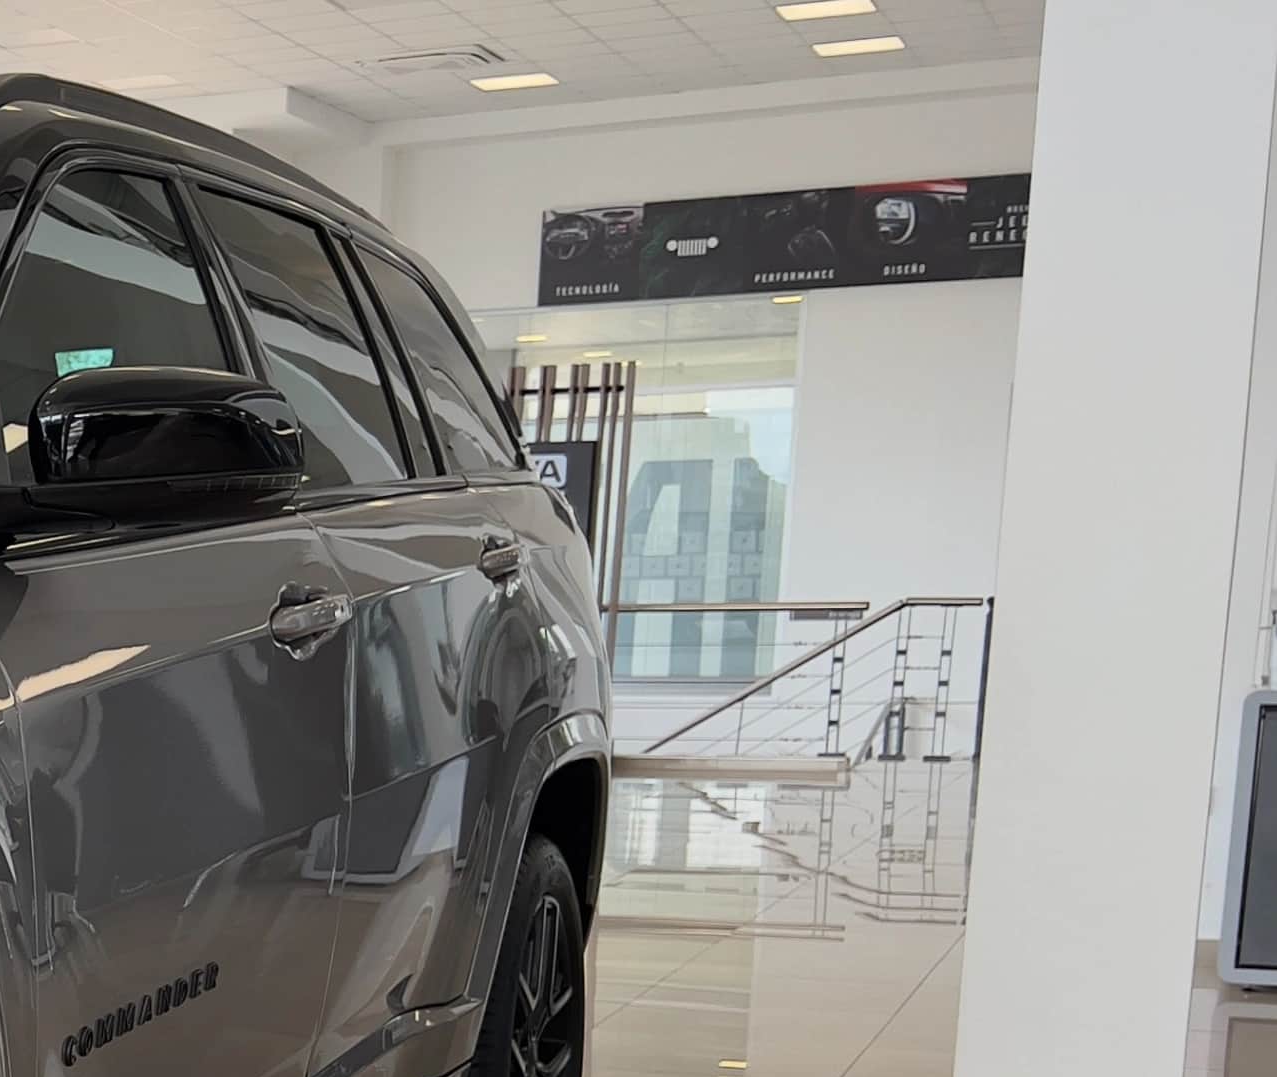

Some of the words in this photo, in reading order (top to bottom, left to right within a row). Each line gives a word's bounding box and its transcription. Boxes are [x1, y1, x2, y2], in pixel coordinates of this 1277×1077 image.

[753, 268, 835, 283] PERFORMANCE
[555, 282, 619, 297] TECNOLOGÍA
[61, 961, 220, 1067] COMMANDER
